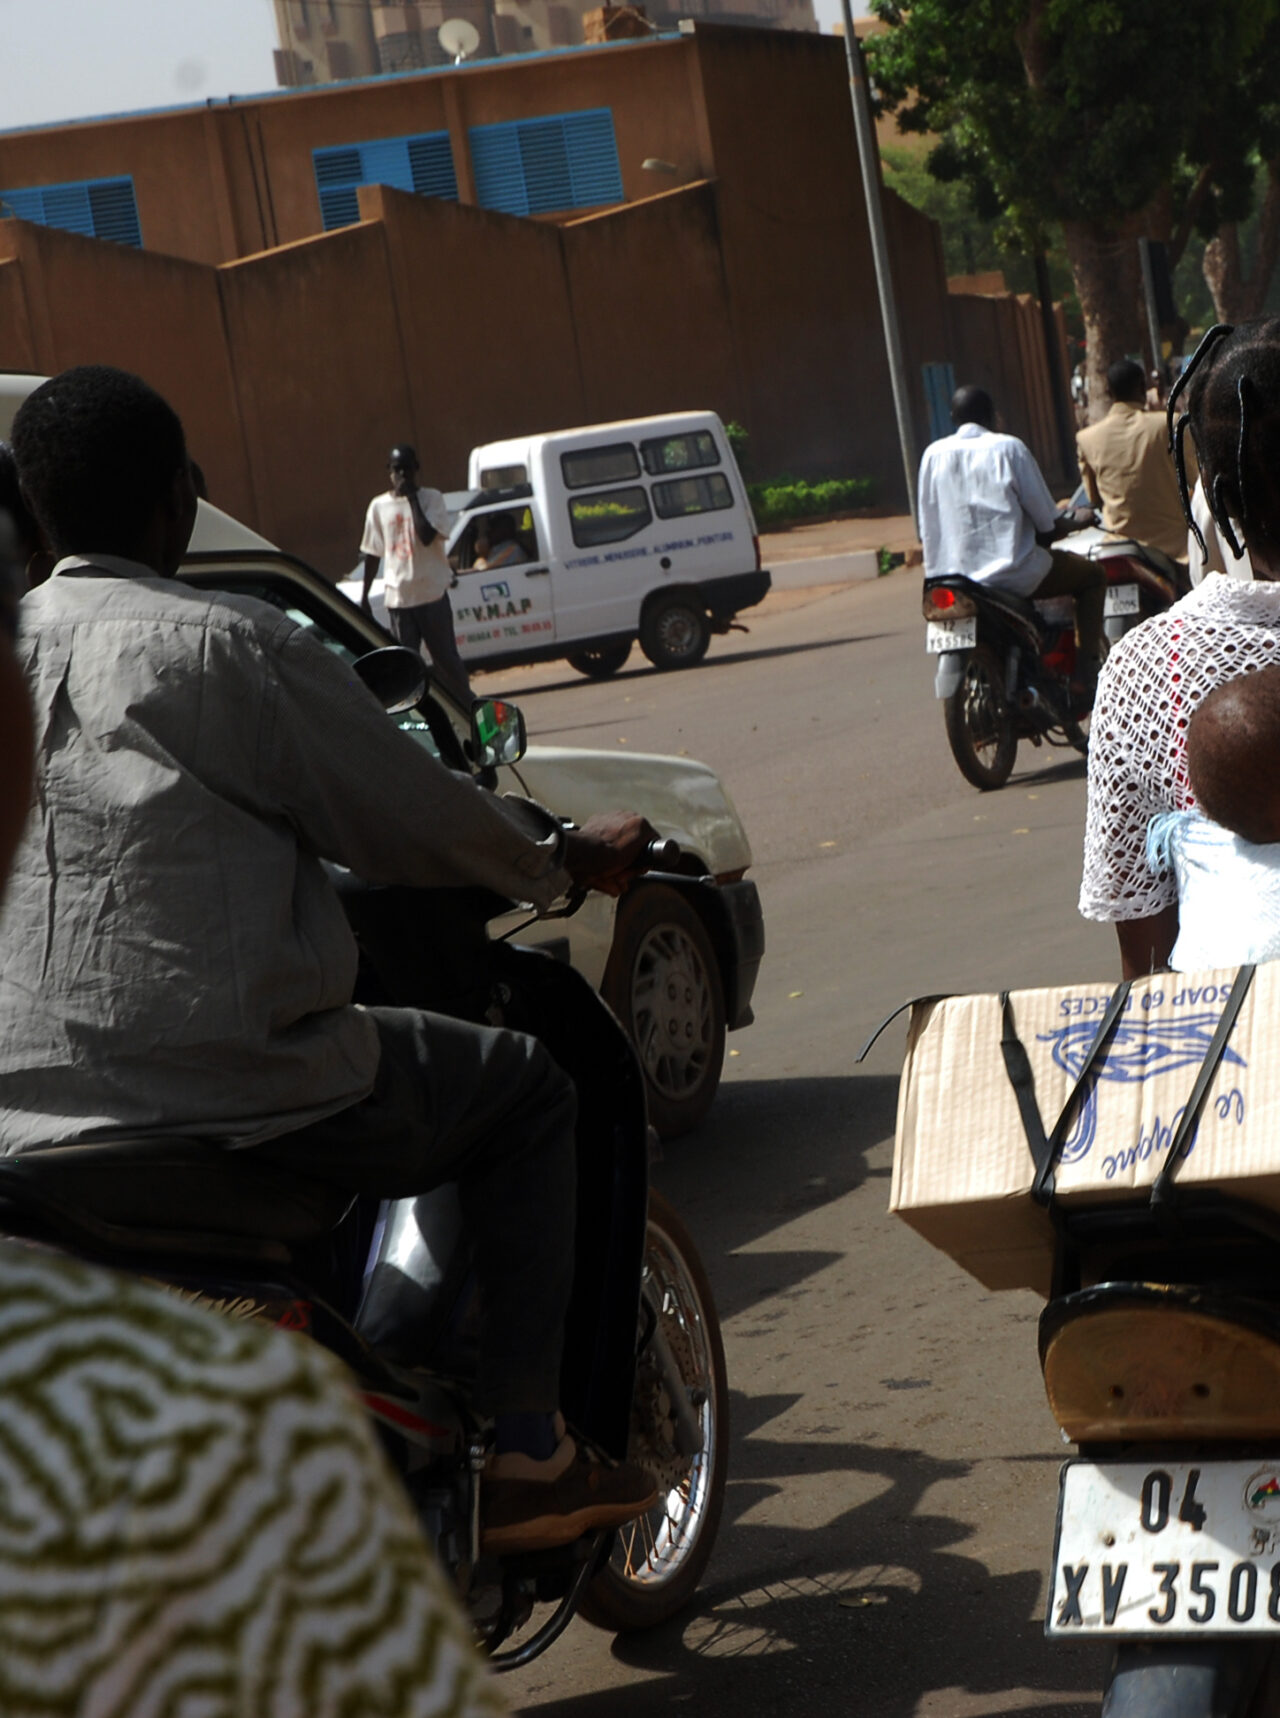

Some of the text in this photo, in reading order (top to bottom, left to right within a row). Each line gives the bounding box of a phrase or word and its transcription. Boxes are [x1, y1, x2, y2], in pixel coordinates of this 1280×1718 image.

[1140, 989, 1165, 1010] 60
[1171, 984, 1233, 1006] SOAP
[1140, 1469, 1207, 1533] 04
[1056, 1563, 1128, 1625] XV
